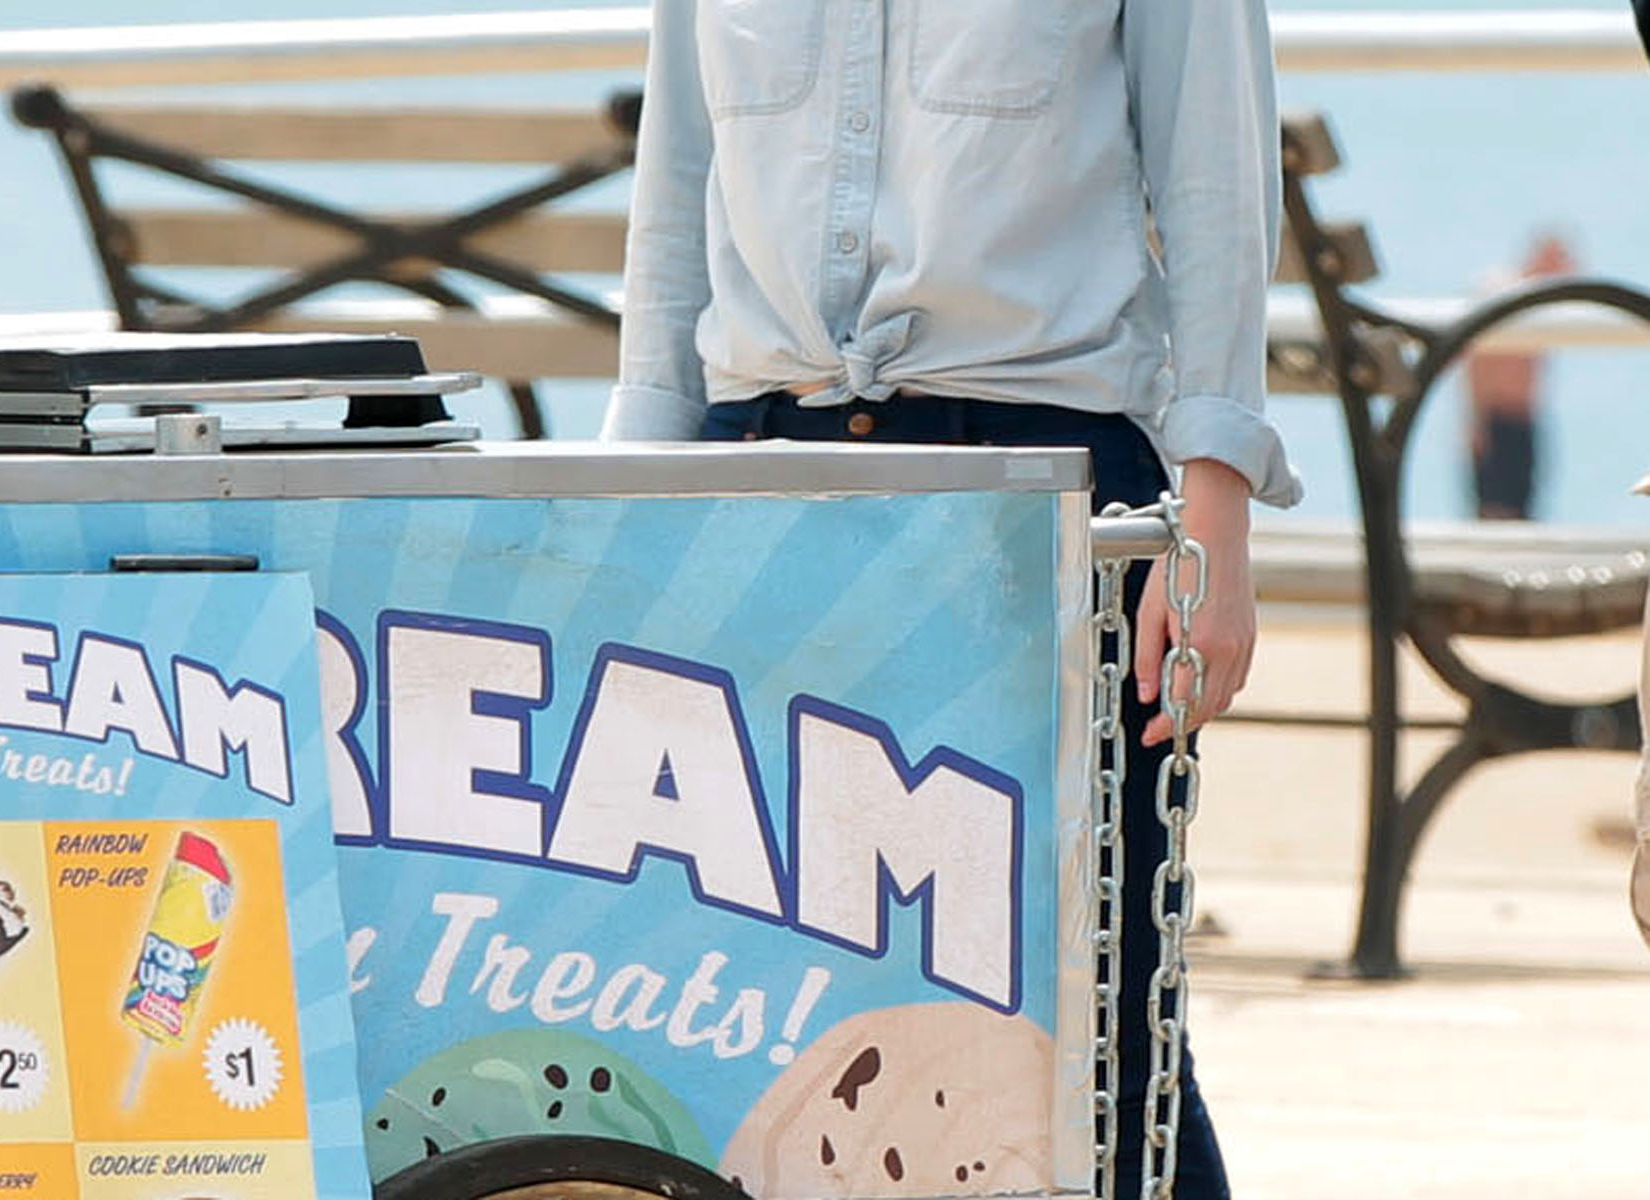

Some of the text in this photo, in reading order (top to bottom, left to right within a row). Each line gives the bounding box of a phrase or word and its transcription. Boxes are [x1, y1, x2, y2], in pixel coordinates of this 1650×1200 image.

[316, 607, 1024, 1015] EAM
[54, 834, 149, 857] RAINBOW
[58, 867, 149, 889] POP-UPS
[142, 932, 197, 974] POP
[413, 893, 832, 1066] Treats!
[225, 1047, 257, 1085] $1
[88, 1153, 266, 1176] COOKIE SANDWICH
